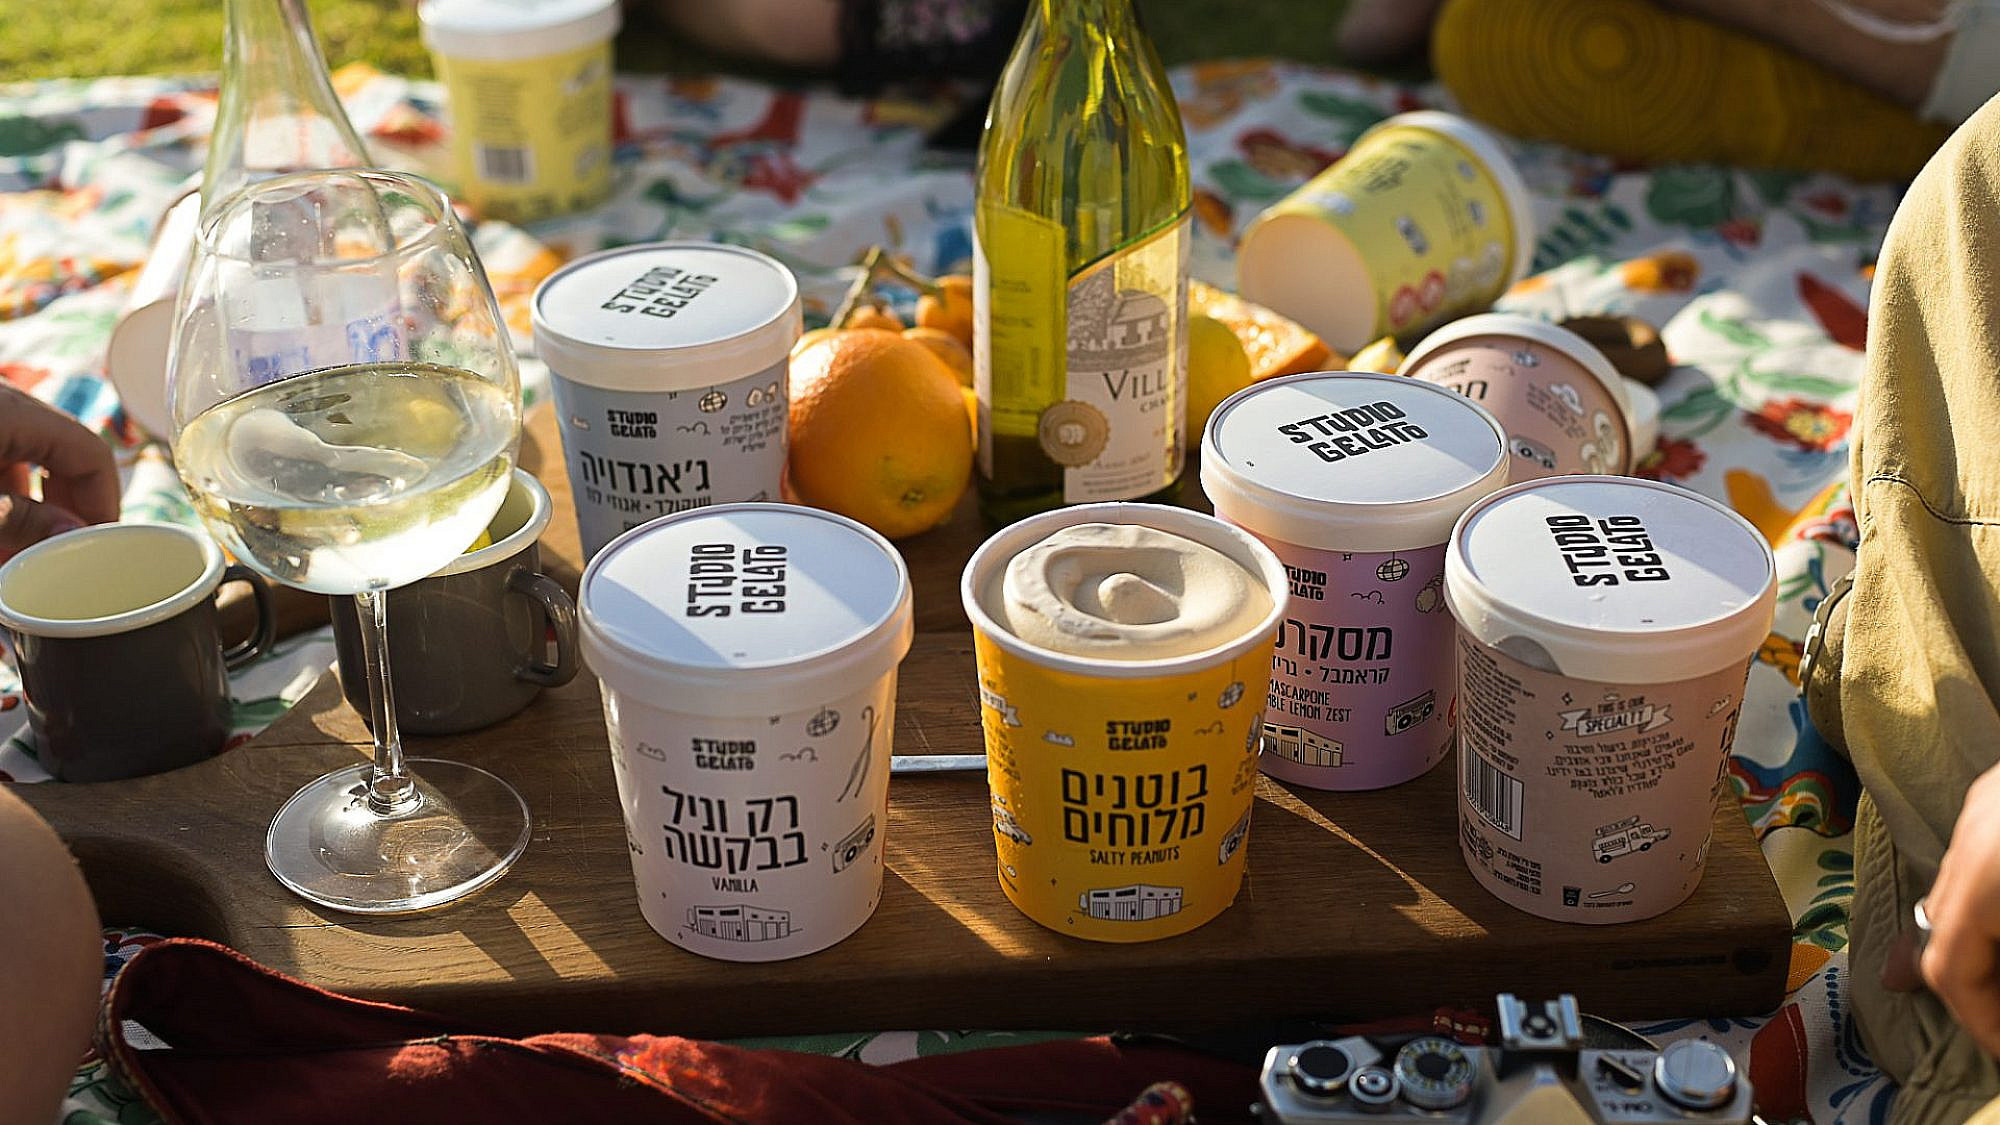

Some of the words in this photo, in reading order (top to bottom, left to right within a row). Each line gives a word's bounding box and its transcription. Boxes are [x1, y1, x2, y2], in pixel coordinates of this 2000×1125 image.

[601, 266, 683, 313] STUDIO
[640, 275, 718, 318] GELATO
[607, 409, 658, 425] STUDIO
[1278, 401, 1406, 443] STUDIO
[611, 424, 657, 439] GELATO
[1307, 417, 1429, 463] GELATO
[655, 496, 711, 514] שוקולד
[1545, 515, 1619, 586] STUDIO
[1598, 516, 1670, 581] GELATO
[687, 543, 737, 617] STUDIO
[741, 544, 787, 613] GELATO
[1283, 564, 1327, 586] TUDIO
[1289, 581, 1324, 600] LATO
[1320, 665, 1391, 685] קראמבל
[1289, 700, 1321, 720] LEMON
[1325, 708, 1352, 722] ZEST
[1586, 711, 1643, 733] SPECIALTY
[1106, 718, 1171, 735] STUDIO
[692, 738, 755, 755] STUDIO
[1108, 735, 1167, 751] GELATO
[696, 754, 754, 770] GELATO
[1061, 763, 1208, 809] בוטנים
[662, 786, 727, 830] וניל
[746, 796, 799, 838] רק
[1063, 802, 1205, 847] מלוחים
[663, 824, 809, 873] בבקשה
[1090, 849, 1125, 865] SALTY
[1131, 846, 1180, 865] PEANUTS
[712, 876, 759, 893] VANILLA
